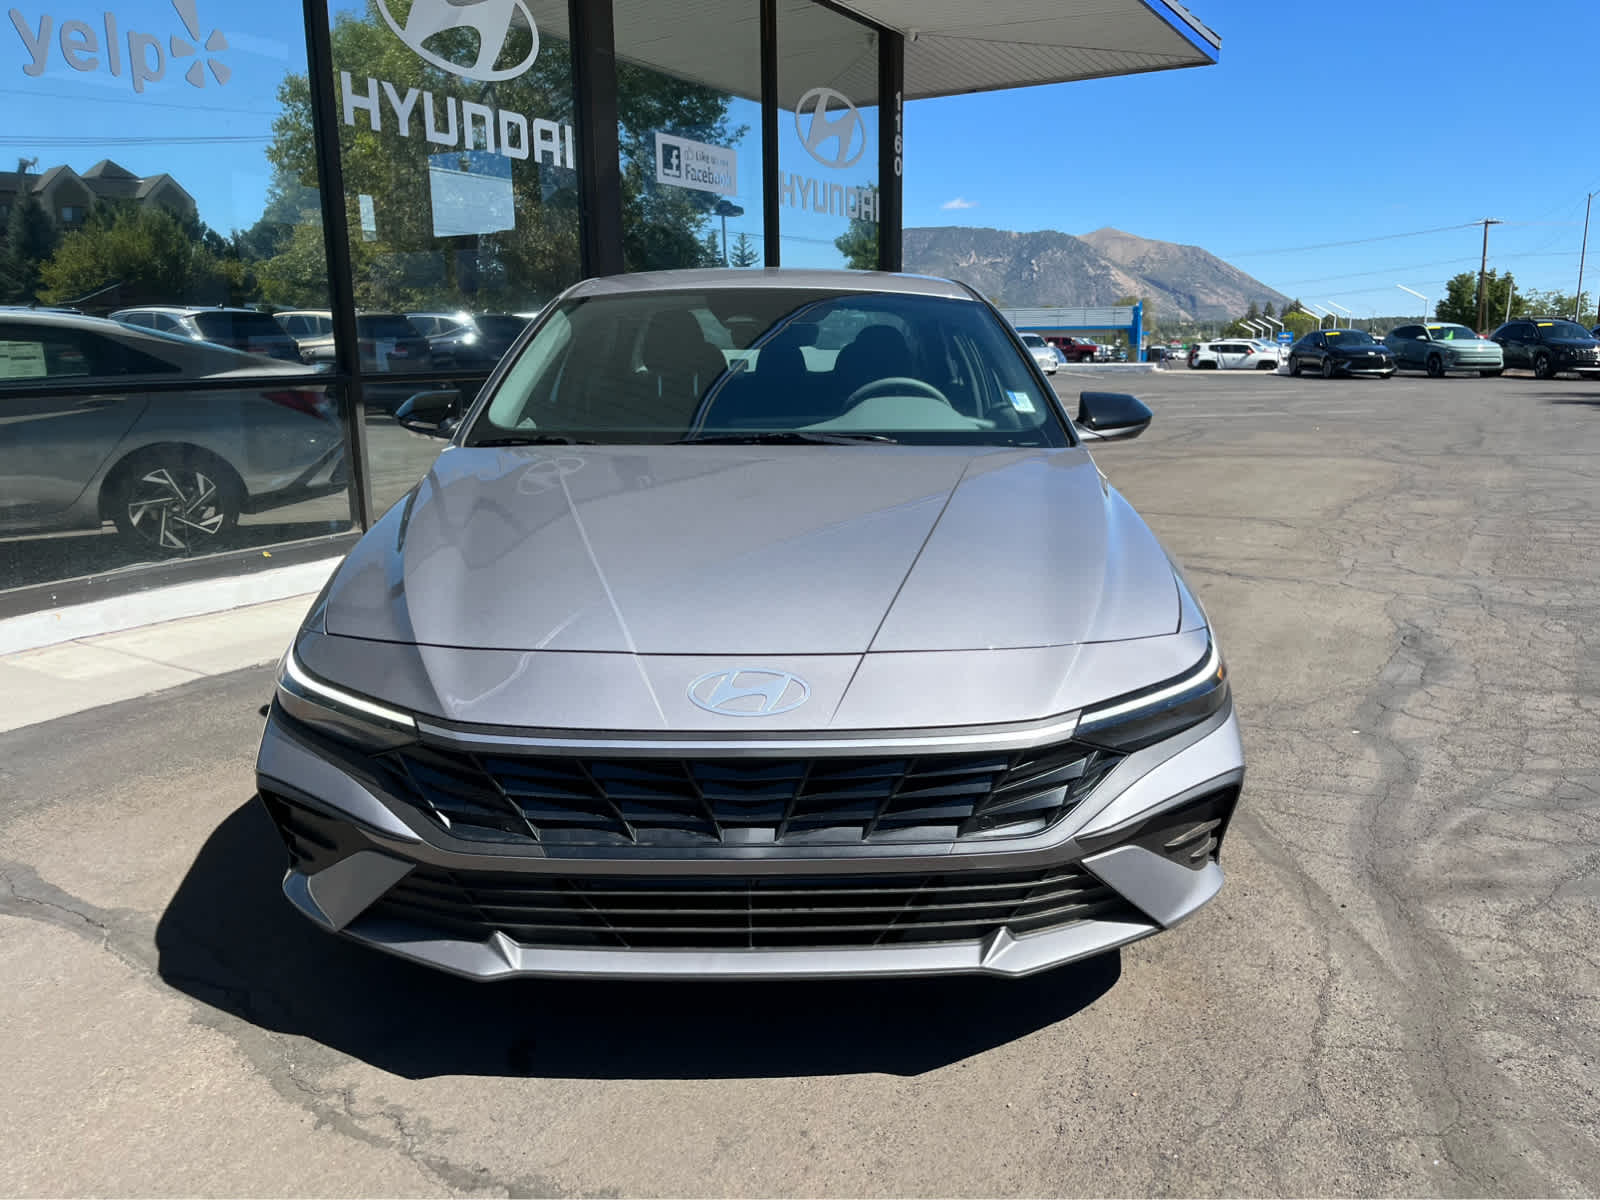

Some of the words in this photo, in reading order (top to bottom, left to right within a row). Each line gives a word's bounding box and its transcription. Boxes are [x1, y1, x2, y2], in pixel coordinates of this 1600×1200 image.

[8, 8, 166, 93] yelp
[340, 71, 574, 169] HYUNDAI
[894, 90, 902, 176] 1160
[779, 170, 879, 223] HYUNDAI
